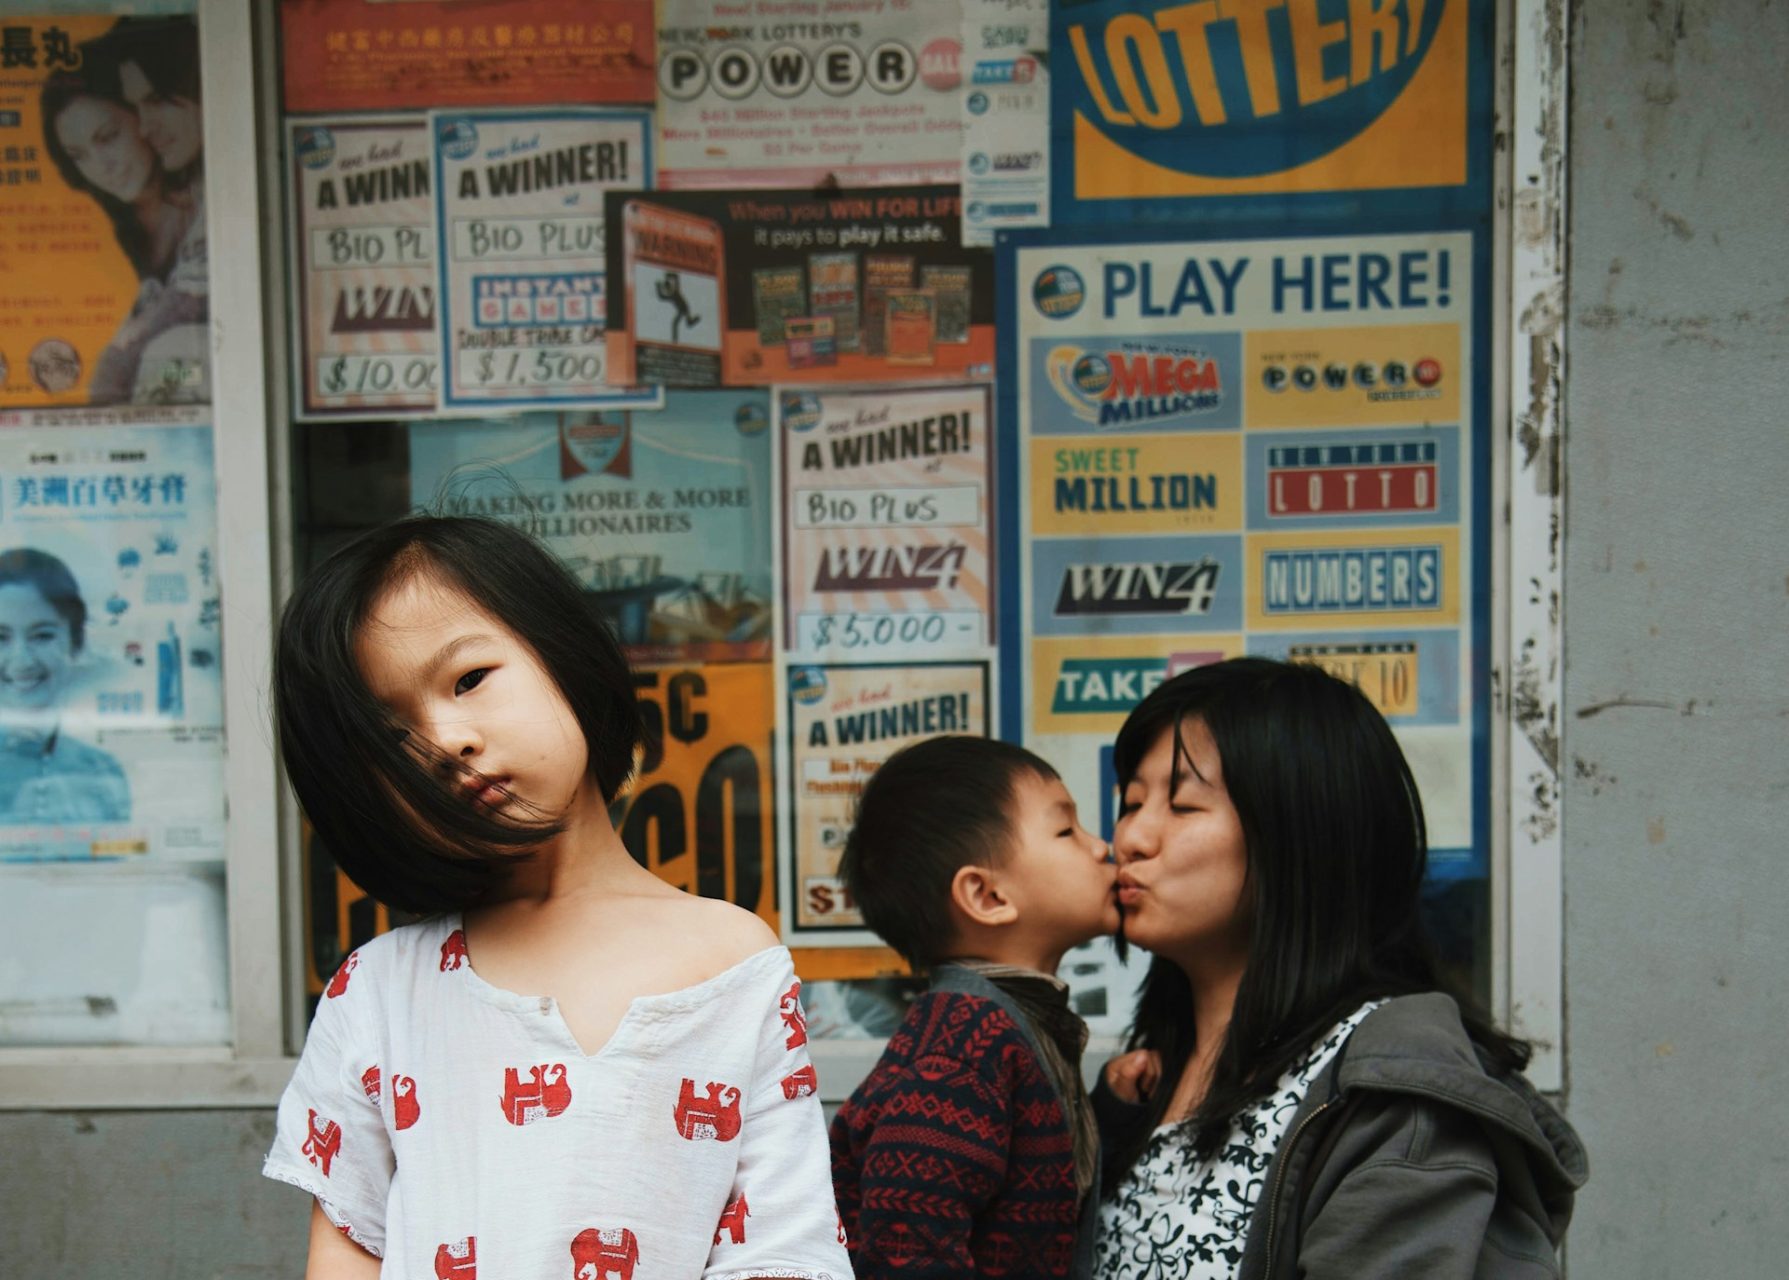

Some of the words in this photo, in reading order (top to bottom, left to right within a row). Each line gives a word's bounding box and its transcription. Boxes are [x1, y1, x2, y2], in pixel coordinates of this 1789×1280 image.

[762, 21, 862, 41] LOTTERY'S
[672, 49, 904, 90] POWER
[663, 128, 700, 141] More
[706, 127, 794, 140] Millionaires
[459, 169, 479, 199] A
[487, 141, 628, 198] WINNER!
[317, 178, 339, 210] A
[728, 200, 786, 221] When
[791, 203, 829, 224] you
[829, 199, 873, 219] WIN
[878, 197, 918, 219] FOR
[754, 228, 767, 245] it
[771, 230, 813, 249] pays
[816, 229, 835, 244] to
[838, 225, 882, 248] play
[884, 225, 899, 242] it
[901, 222, 948, 243] safe.
[1102, 257, 1250, 319] PLAY
[1272, 249, 1452, 314] HERE!
[1104, 353, 1219, 400] MEGA
[1266, 363, 1408, 391] POWER
[1099, 392, 1219, 426] MILLIONS
[802, 442, 823, 471] A
[830, 411, 971, 469] WINNER!
[1054, 447, 1139, 473] SWEET
[14, 473, 188, 509] 美洲百草牙膏
[448, 492, 556, 515] MAKING
[562, 491, 640, 513] MORE
[645, 490, 666, 509] &
[673, 488, 752, 510] MORE
[1055, 473, 1217, 513] MILLION
[1274, 469, 1430, 512] LOTTO
[512, 511, 693, 538] ILLIONAIRES
[1270, 554, 1436, 606] NUMBERS
[1380, 659, 1408, 707] 10
[809, 721, 829, 748] A
[836, 693, 970, 746] WINNER!
